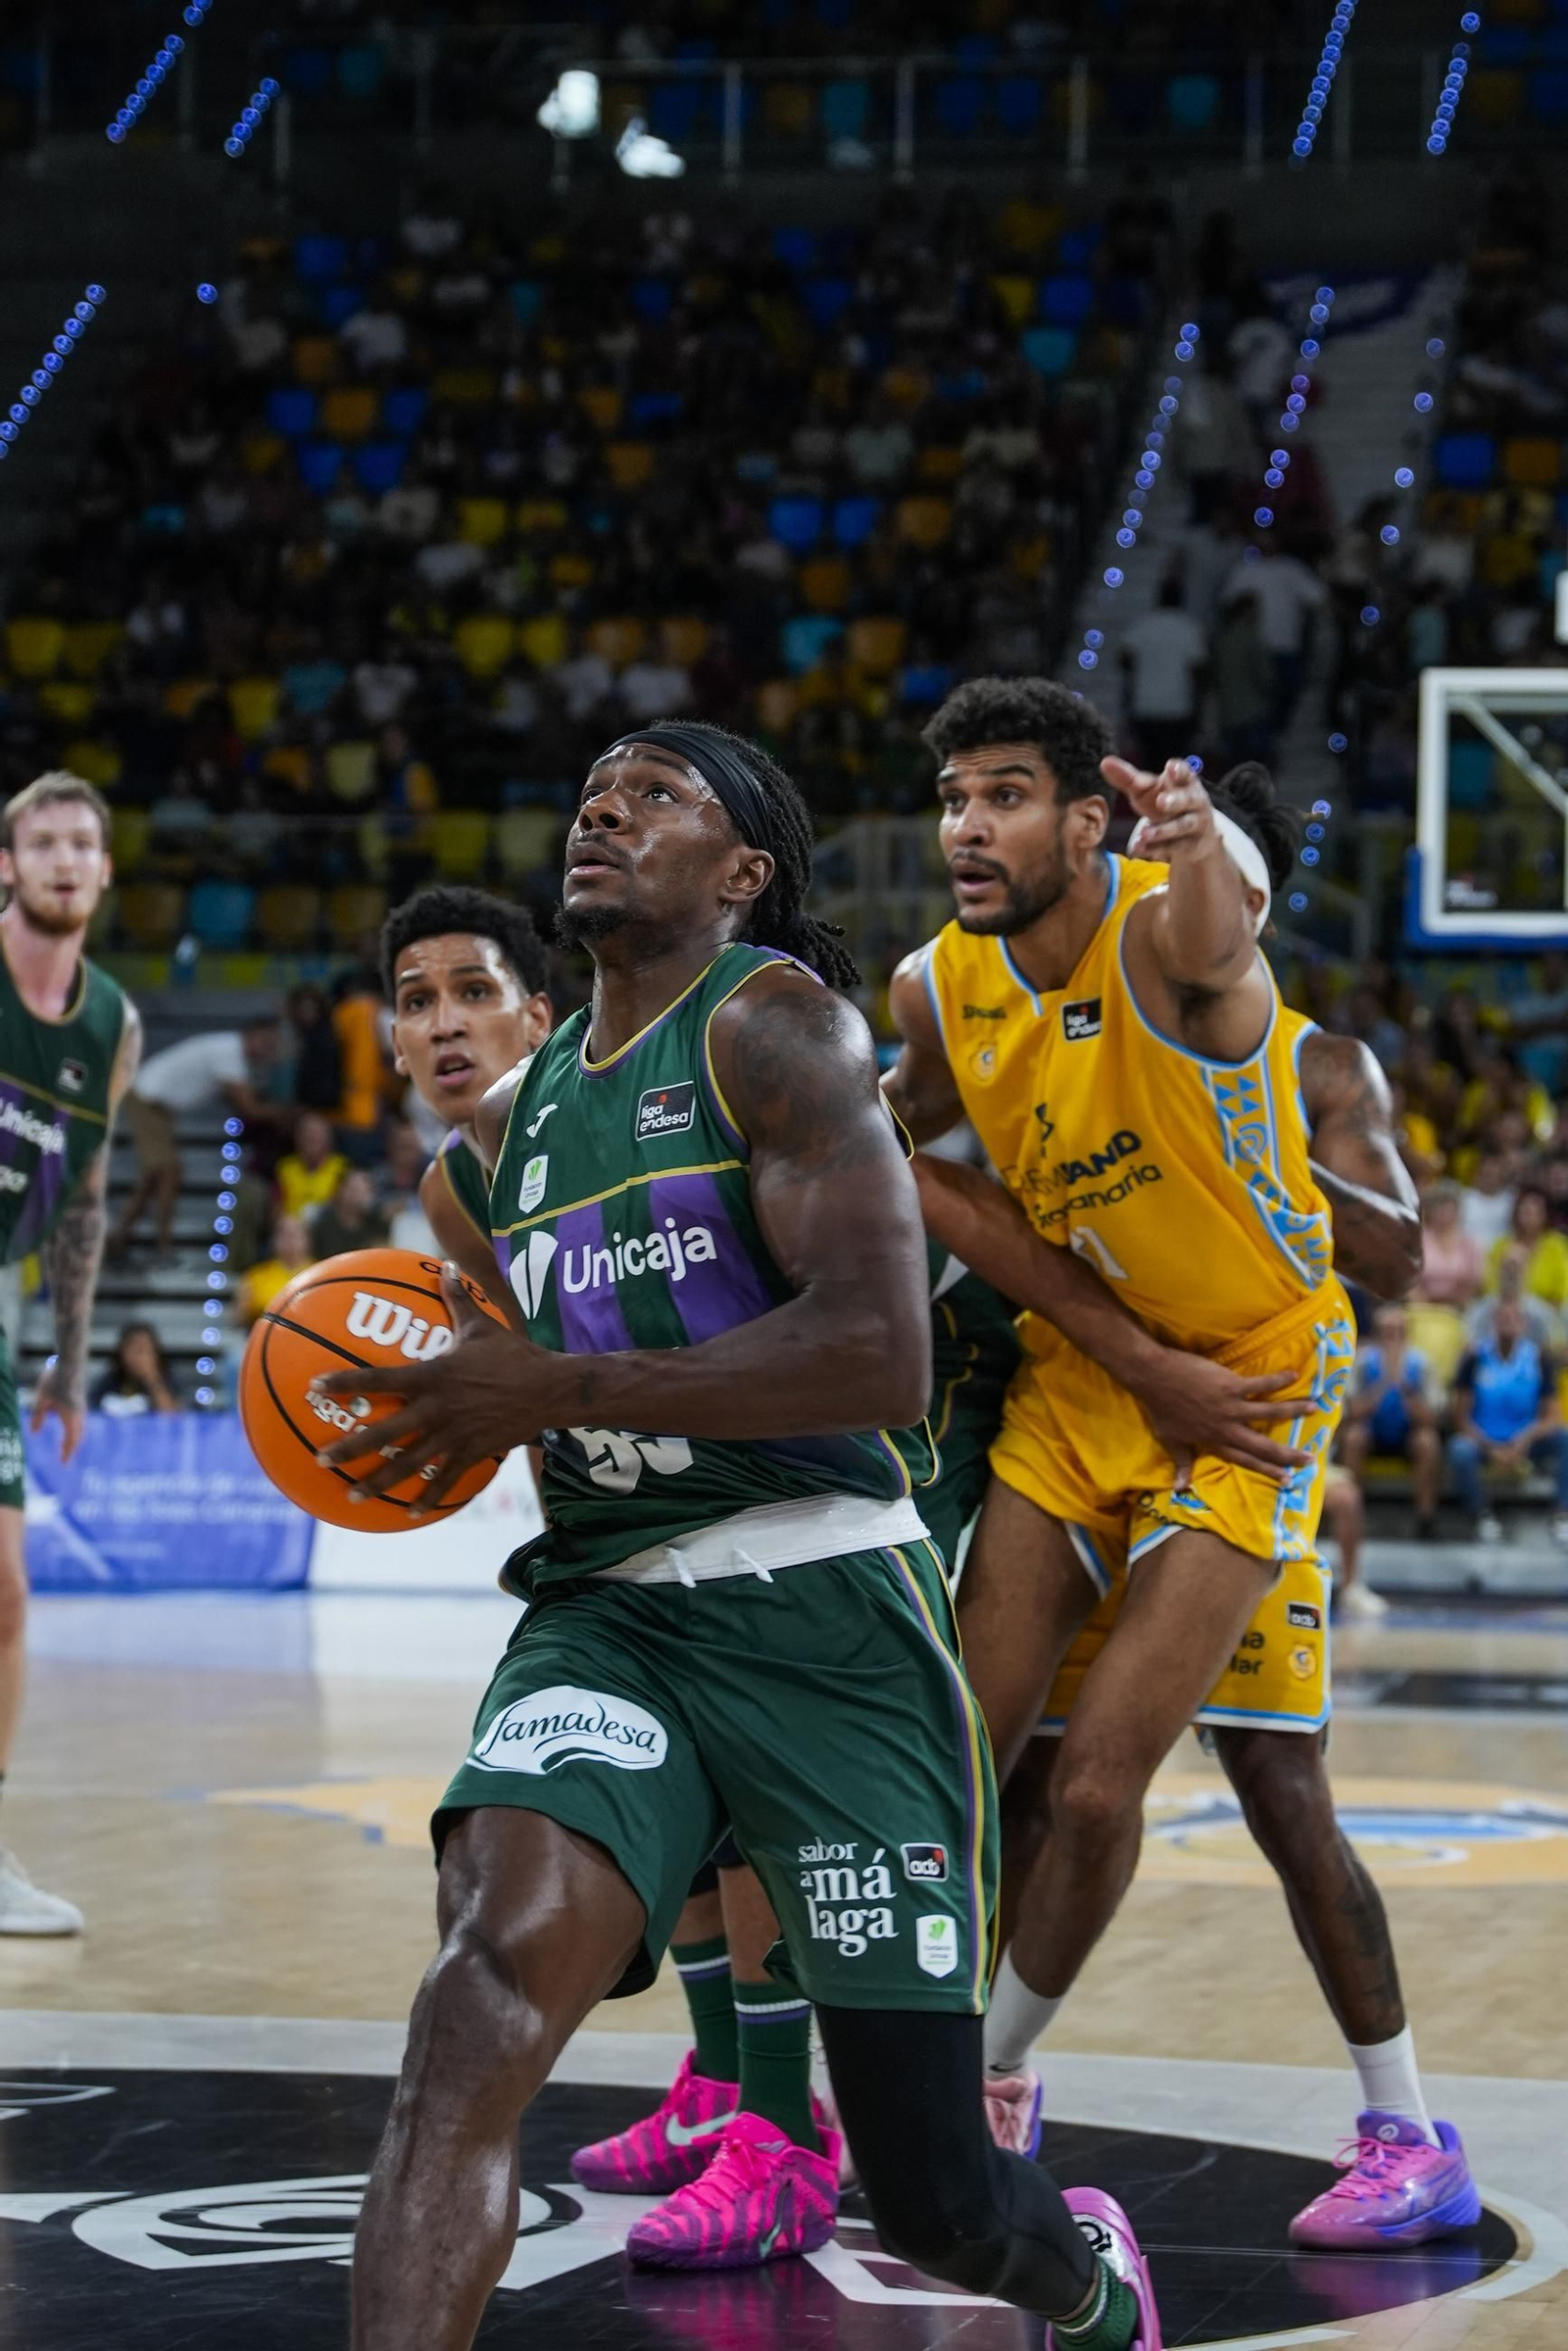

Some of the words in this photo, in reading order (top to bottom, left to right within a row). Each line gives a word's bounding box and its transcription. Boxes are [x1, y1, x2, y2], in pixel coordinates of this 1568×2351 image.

[639, 1112, 689, 1132] endesa
[641, 1104, 664, 1119] liga
[563, 1217, 717, 1294] Unicaja
[346, 1291, 455, 1362] Wil
[480, 1700, 658, 1757] famadesa
[798, 1836, 858, 1862] sabor
[800, 1847, 898, 1901] amá
[804, 1894, 900, 1957] laga
